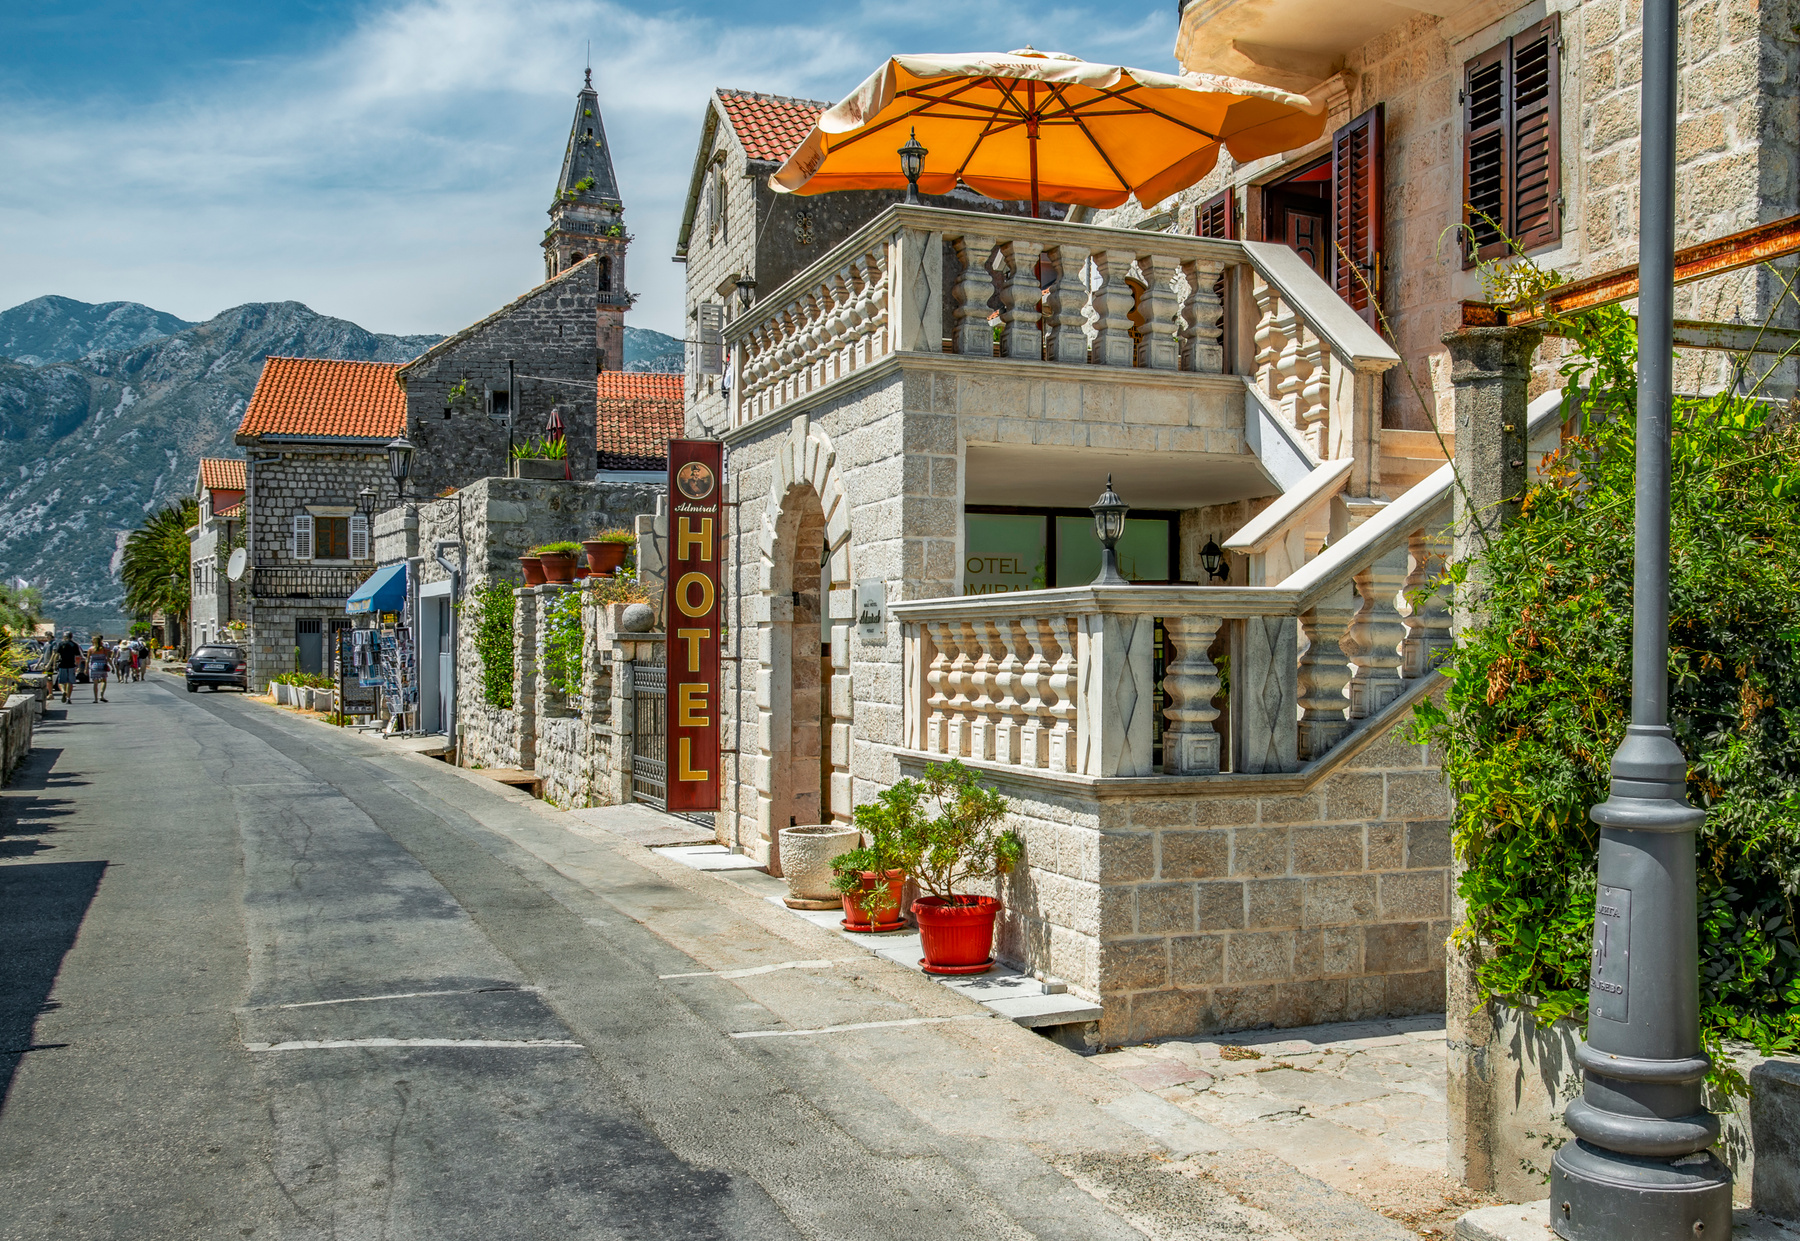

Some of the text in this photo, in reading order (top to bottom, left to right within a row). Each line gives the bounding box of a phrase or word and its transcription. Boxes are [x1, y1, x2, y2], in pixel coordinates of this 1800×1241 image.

[674, 502, 717, 513] Admiral
[966, 557, 1027, 575] OTEL
[676, 517, 715, 782] HOTEL
